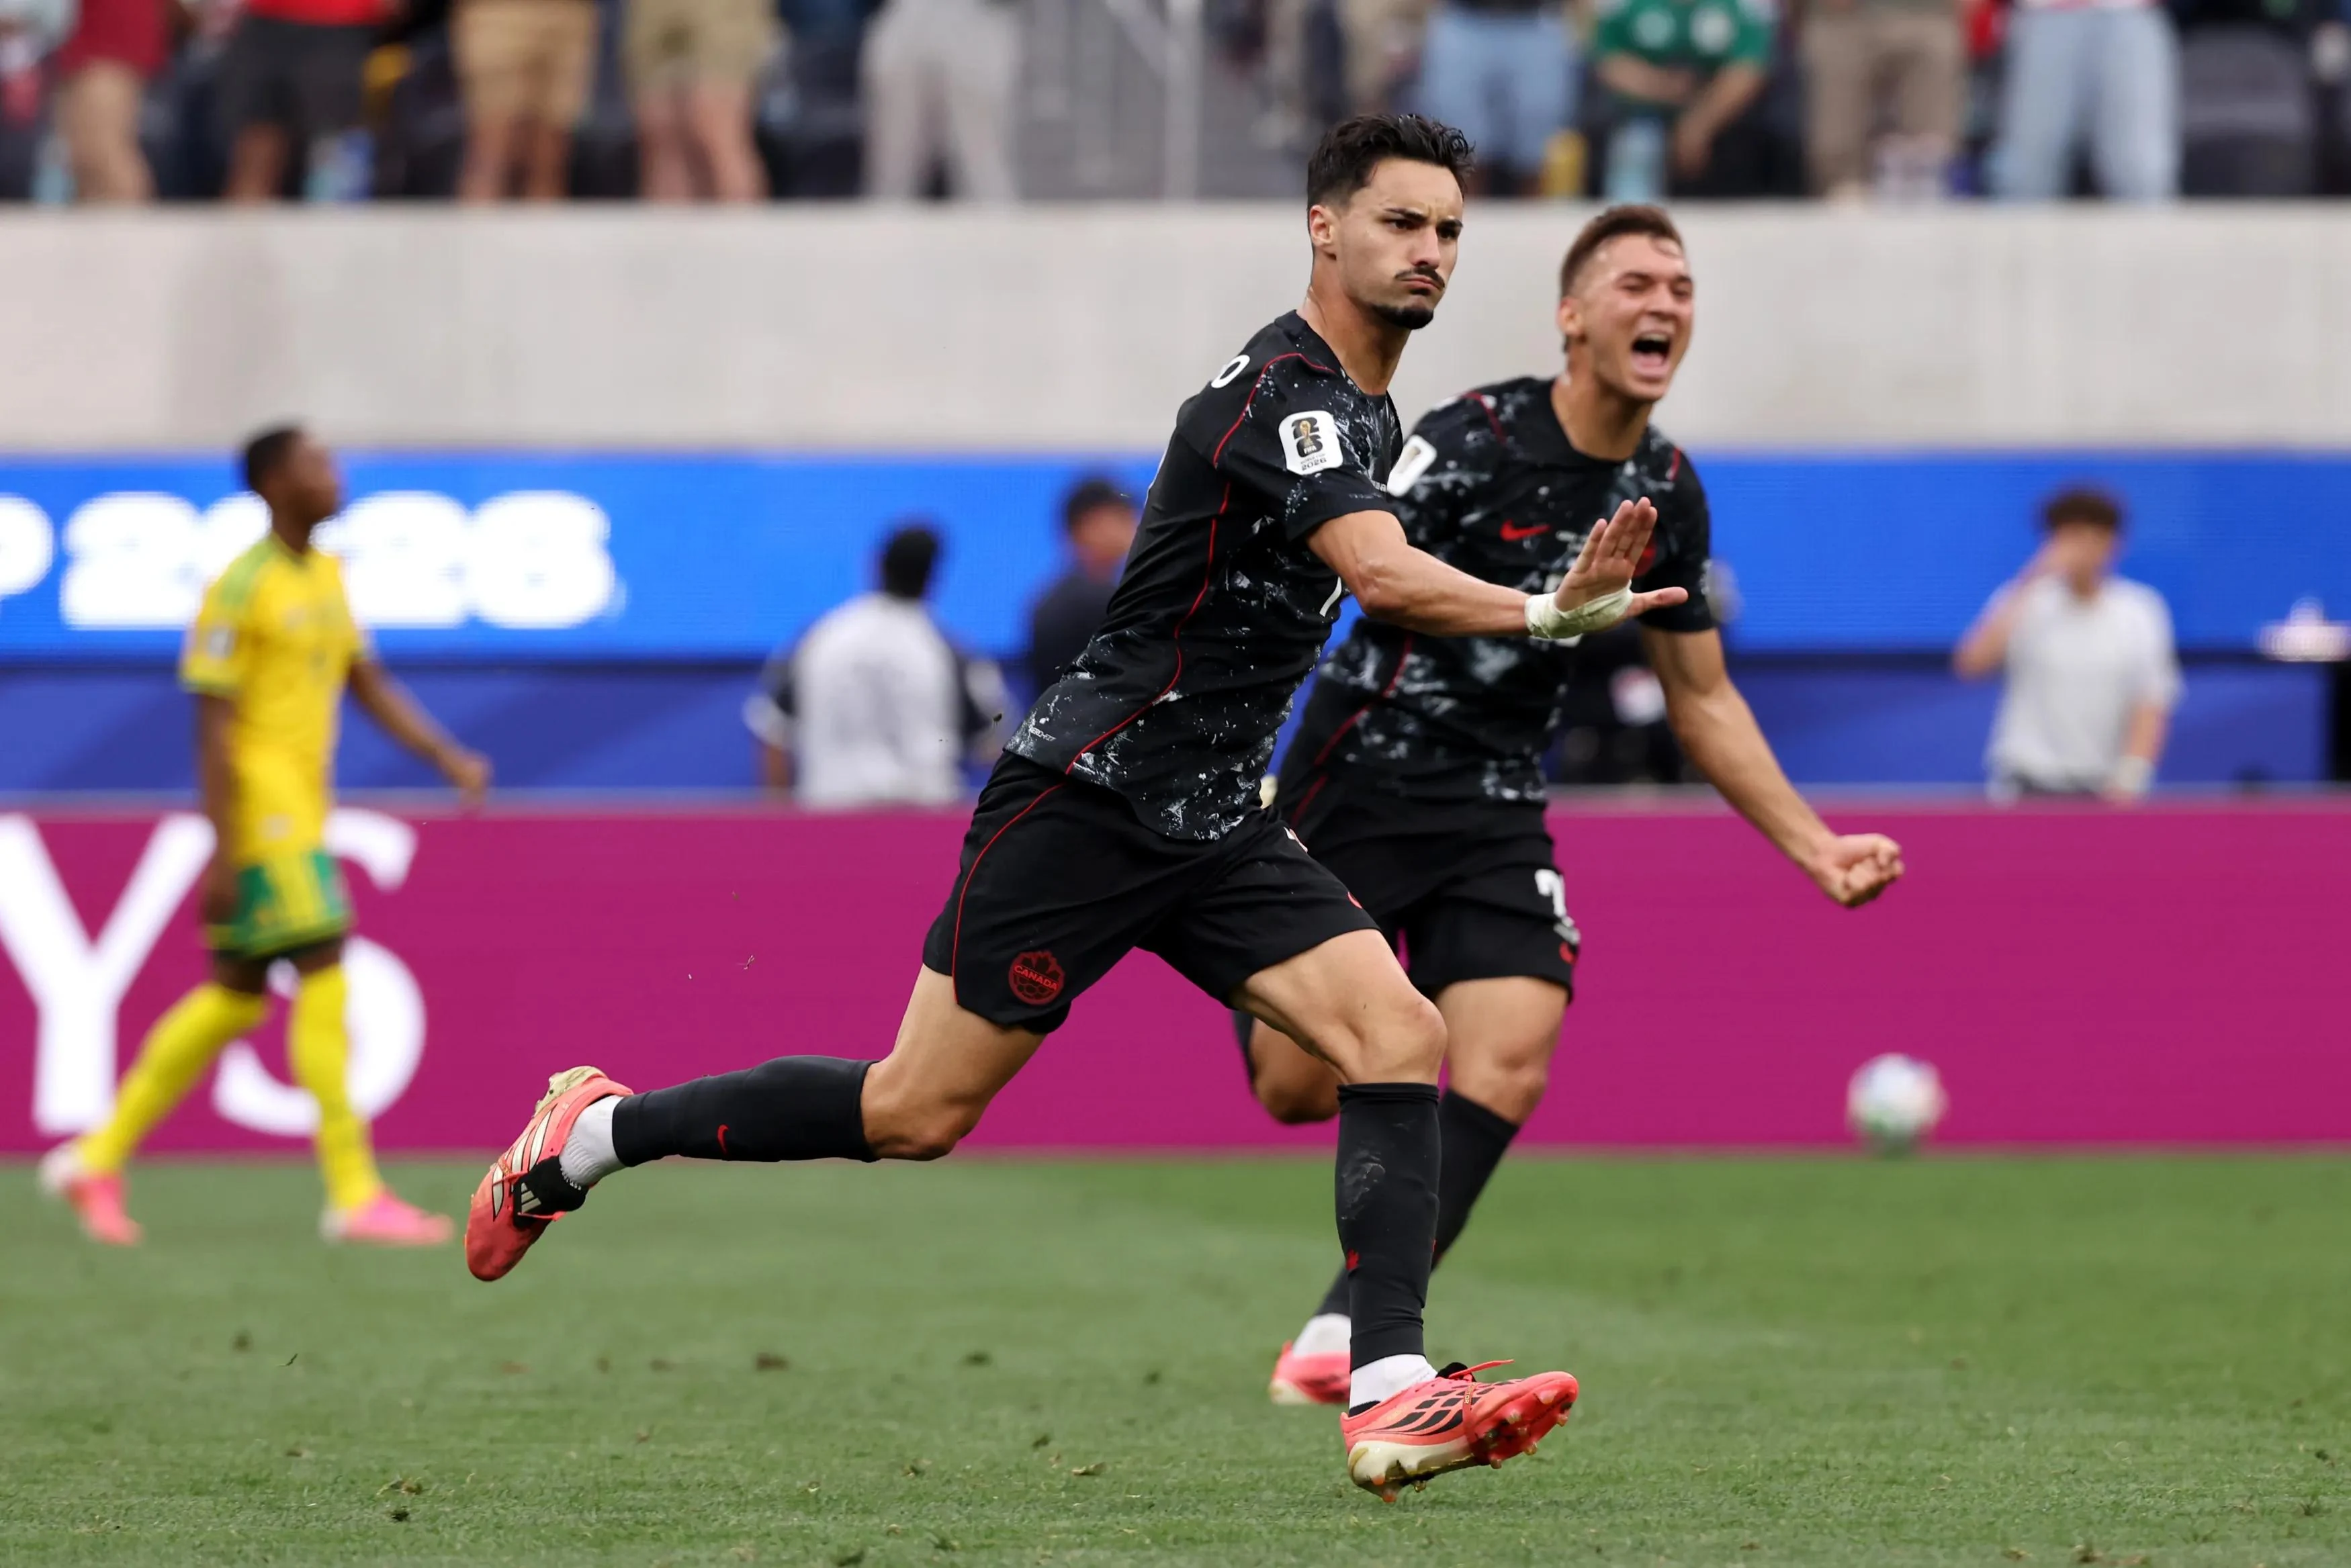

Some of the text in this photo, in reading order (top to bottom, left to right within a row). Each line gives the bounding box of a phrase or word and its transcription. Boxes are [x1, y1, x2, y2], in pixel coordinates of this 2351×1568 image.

[1301, 457, 1327, 471] 2026
[60, 490, 616, 630] 226
[1013, 965, 1059, 991] CANADA
